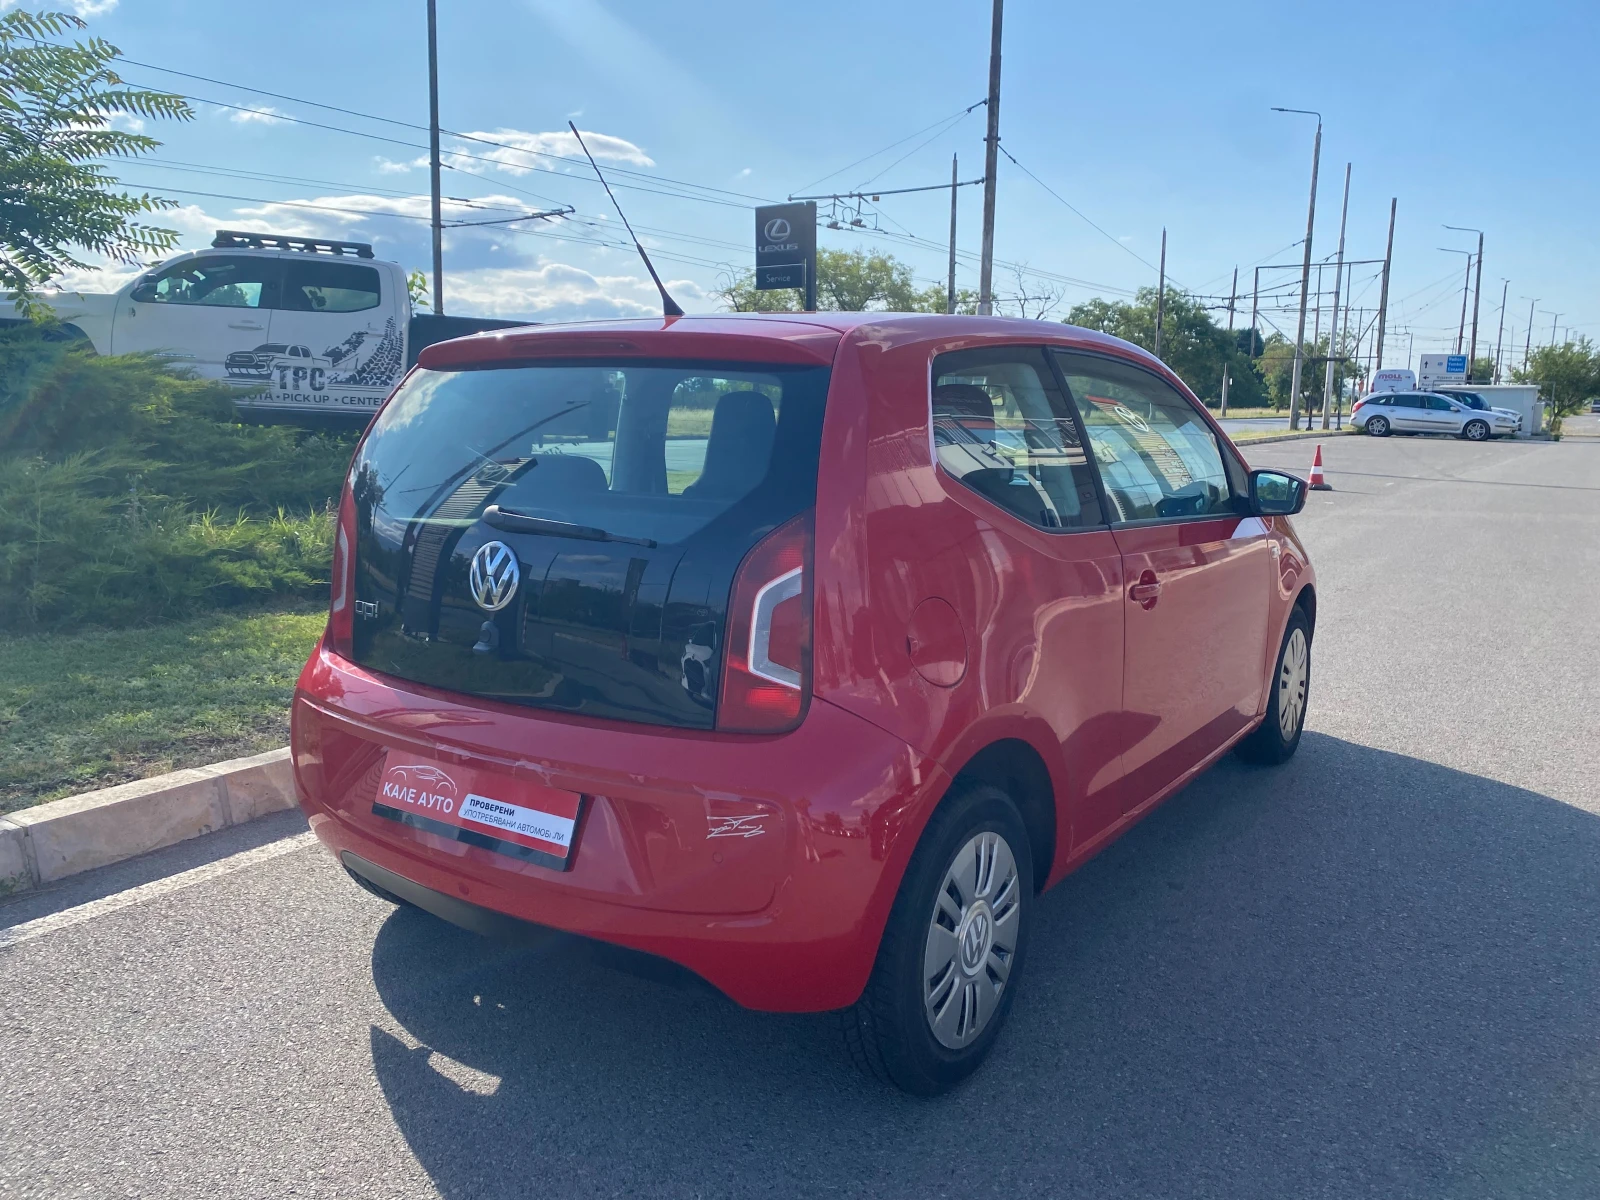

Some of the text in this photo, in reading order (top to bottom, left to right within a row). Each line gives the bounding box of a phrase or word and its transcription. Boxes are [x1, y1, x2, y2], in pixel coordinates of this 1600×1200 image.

[758, 243, 799, 253] LEXUS
[766, 274, 791, 283] Service
[276, 365, 326, 392] TPC
[283, 393, 311, 403] PICK
[314, 394, 330, 403] UP
[382, 781, 454, 813] КАЛЕ АУТО
[469, 799, 515, 817] ПРОВЕРЕНИ
[463, 809, 517, 830] УПОТРЕБЯВАНИ
